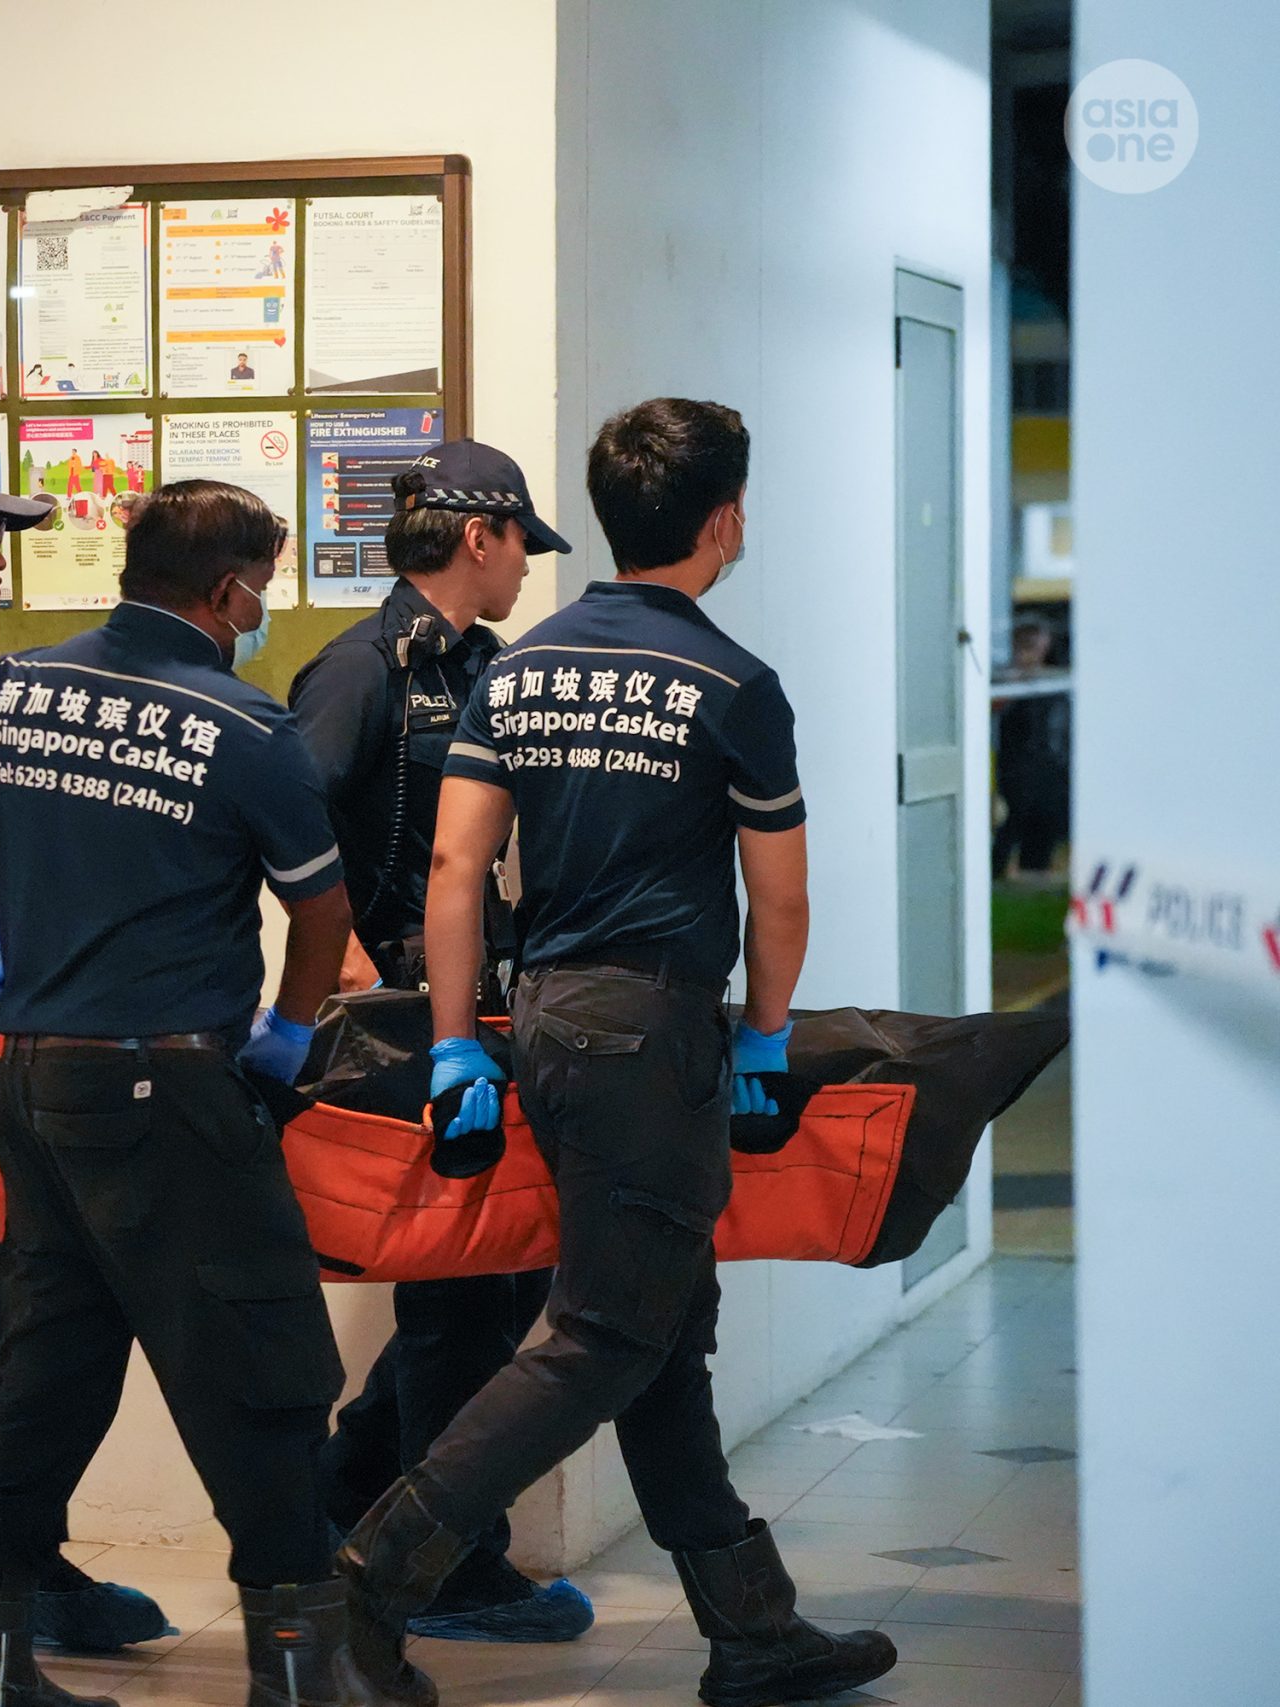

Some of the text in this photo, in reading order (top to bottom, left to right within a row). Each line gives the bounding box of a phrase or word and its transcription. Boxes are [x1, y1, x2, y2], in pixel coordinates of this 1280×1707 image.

[102, 213, 136, 224] Payment
[346, 211, 374, 219] COURT
[344, 219, 366, 227] RATES
[400, 218, 440, 226] GUIDELINES
[169, 420, 273, 430] SMOKING IS PROHIBITED
[169, 431, 178, 439] IN
[209, 430, 240, 438] PLACES
[310, 427, 407, 437] FIRE EXTINGUISHER
[168, 448, 204, 456] DILARANG
[488, 666, 703, 719] 新加坡殡仪馆
[600, 707, 690, 746] Casket
[109, 738, 208, 787] Casket
[605, 749, 681, 783] (24hrs)
[60, 772, 111, 800] 4388
[113, 781, 194, 825] (24hrs)
